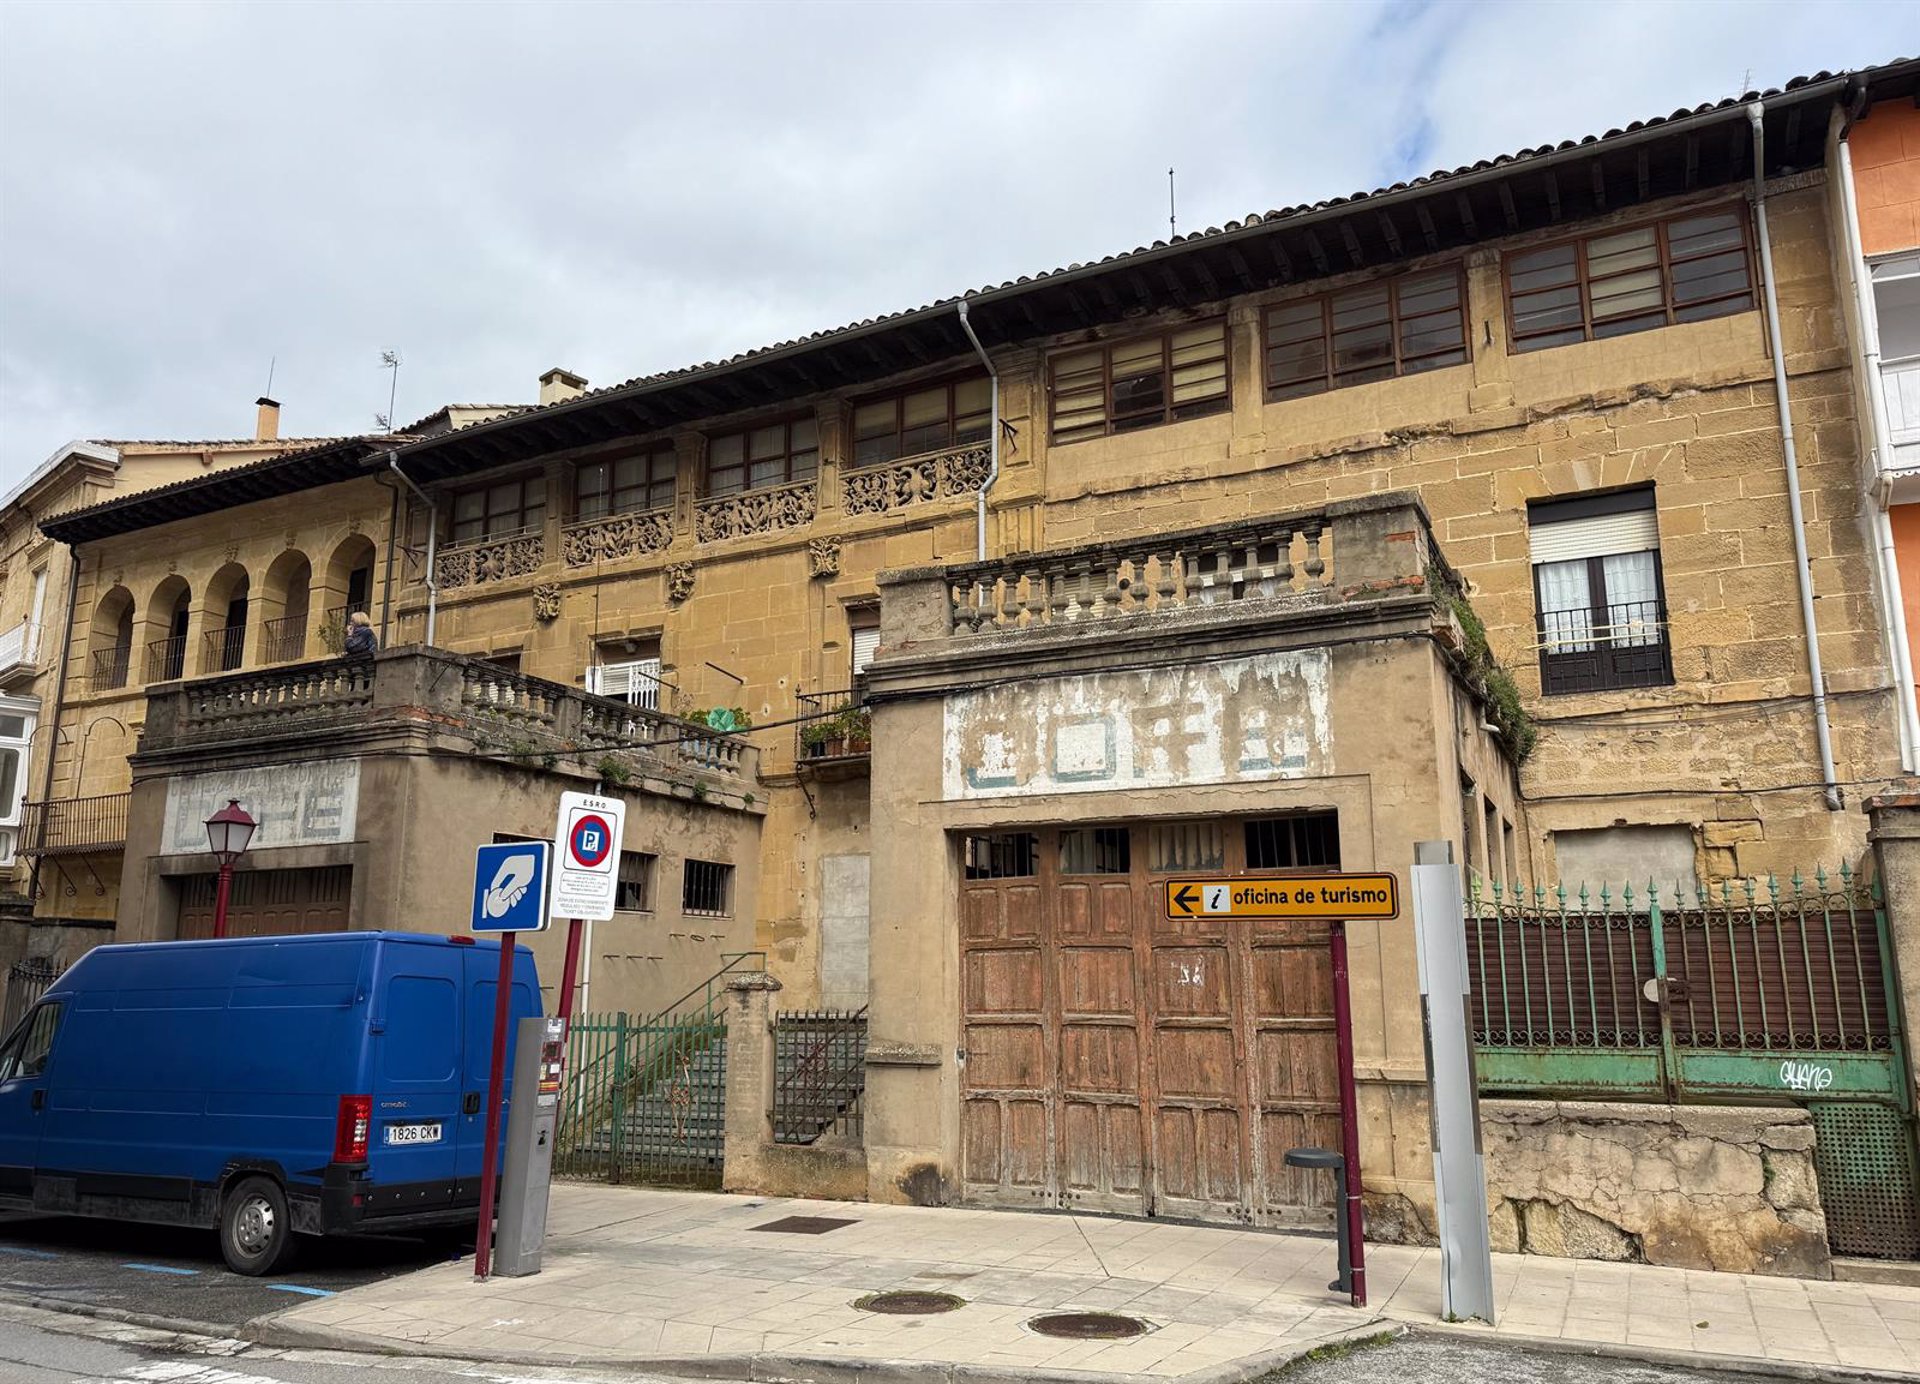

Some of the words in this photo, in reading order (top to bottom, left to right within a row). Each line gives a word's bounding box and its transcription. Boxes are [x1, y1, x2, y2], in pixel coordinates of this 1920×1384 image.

[583, 799, 607, 809] ESRO
[1233, 887, 1289, 905] oficina
[1294, 888, 1316, 904] de
[1320, 886, 1388, 904] turismo
[393, 1127, 418, 1141] 1826
